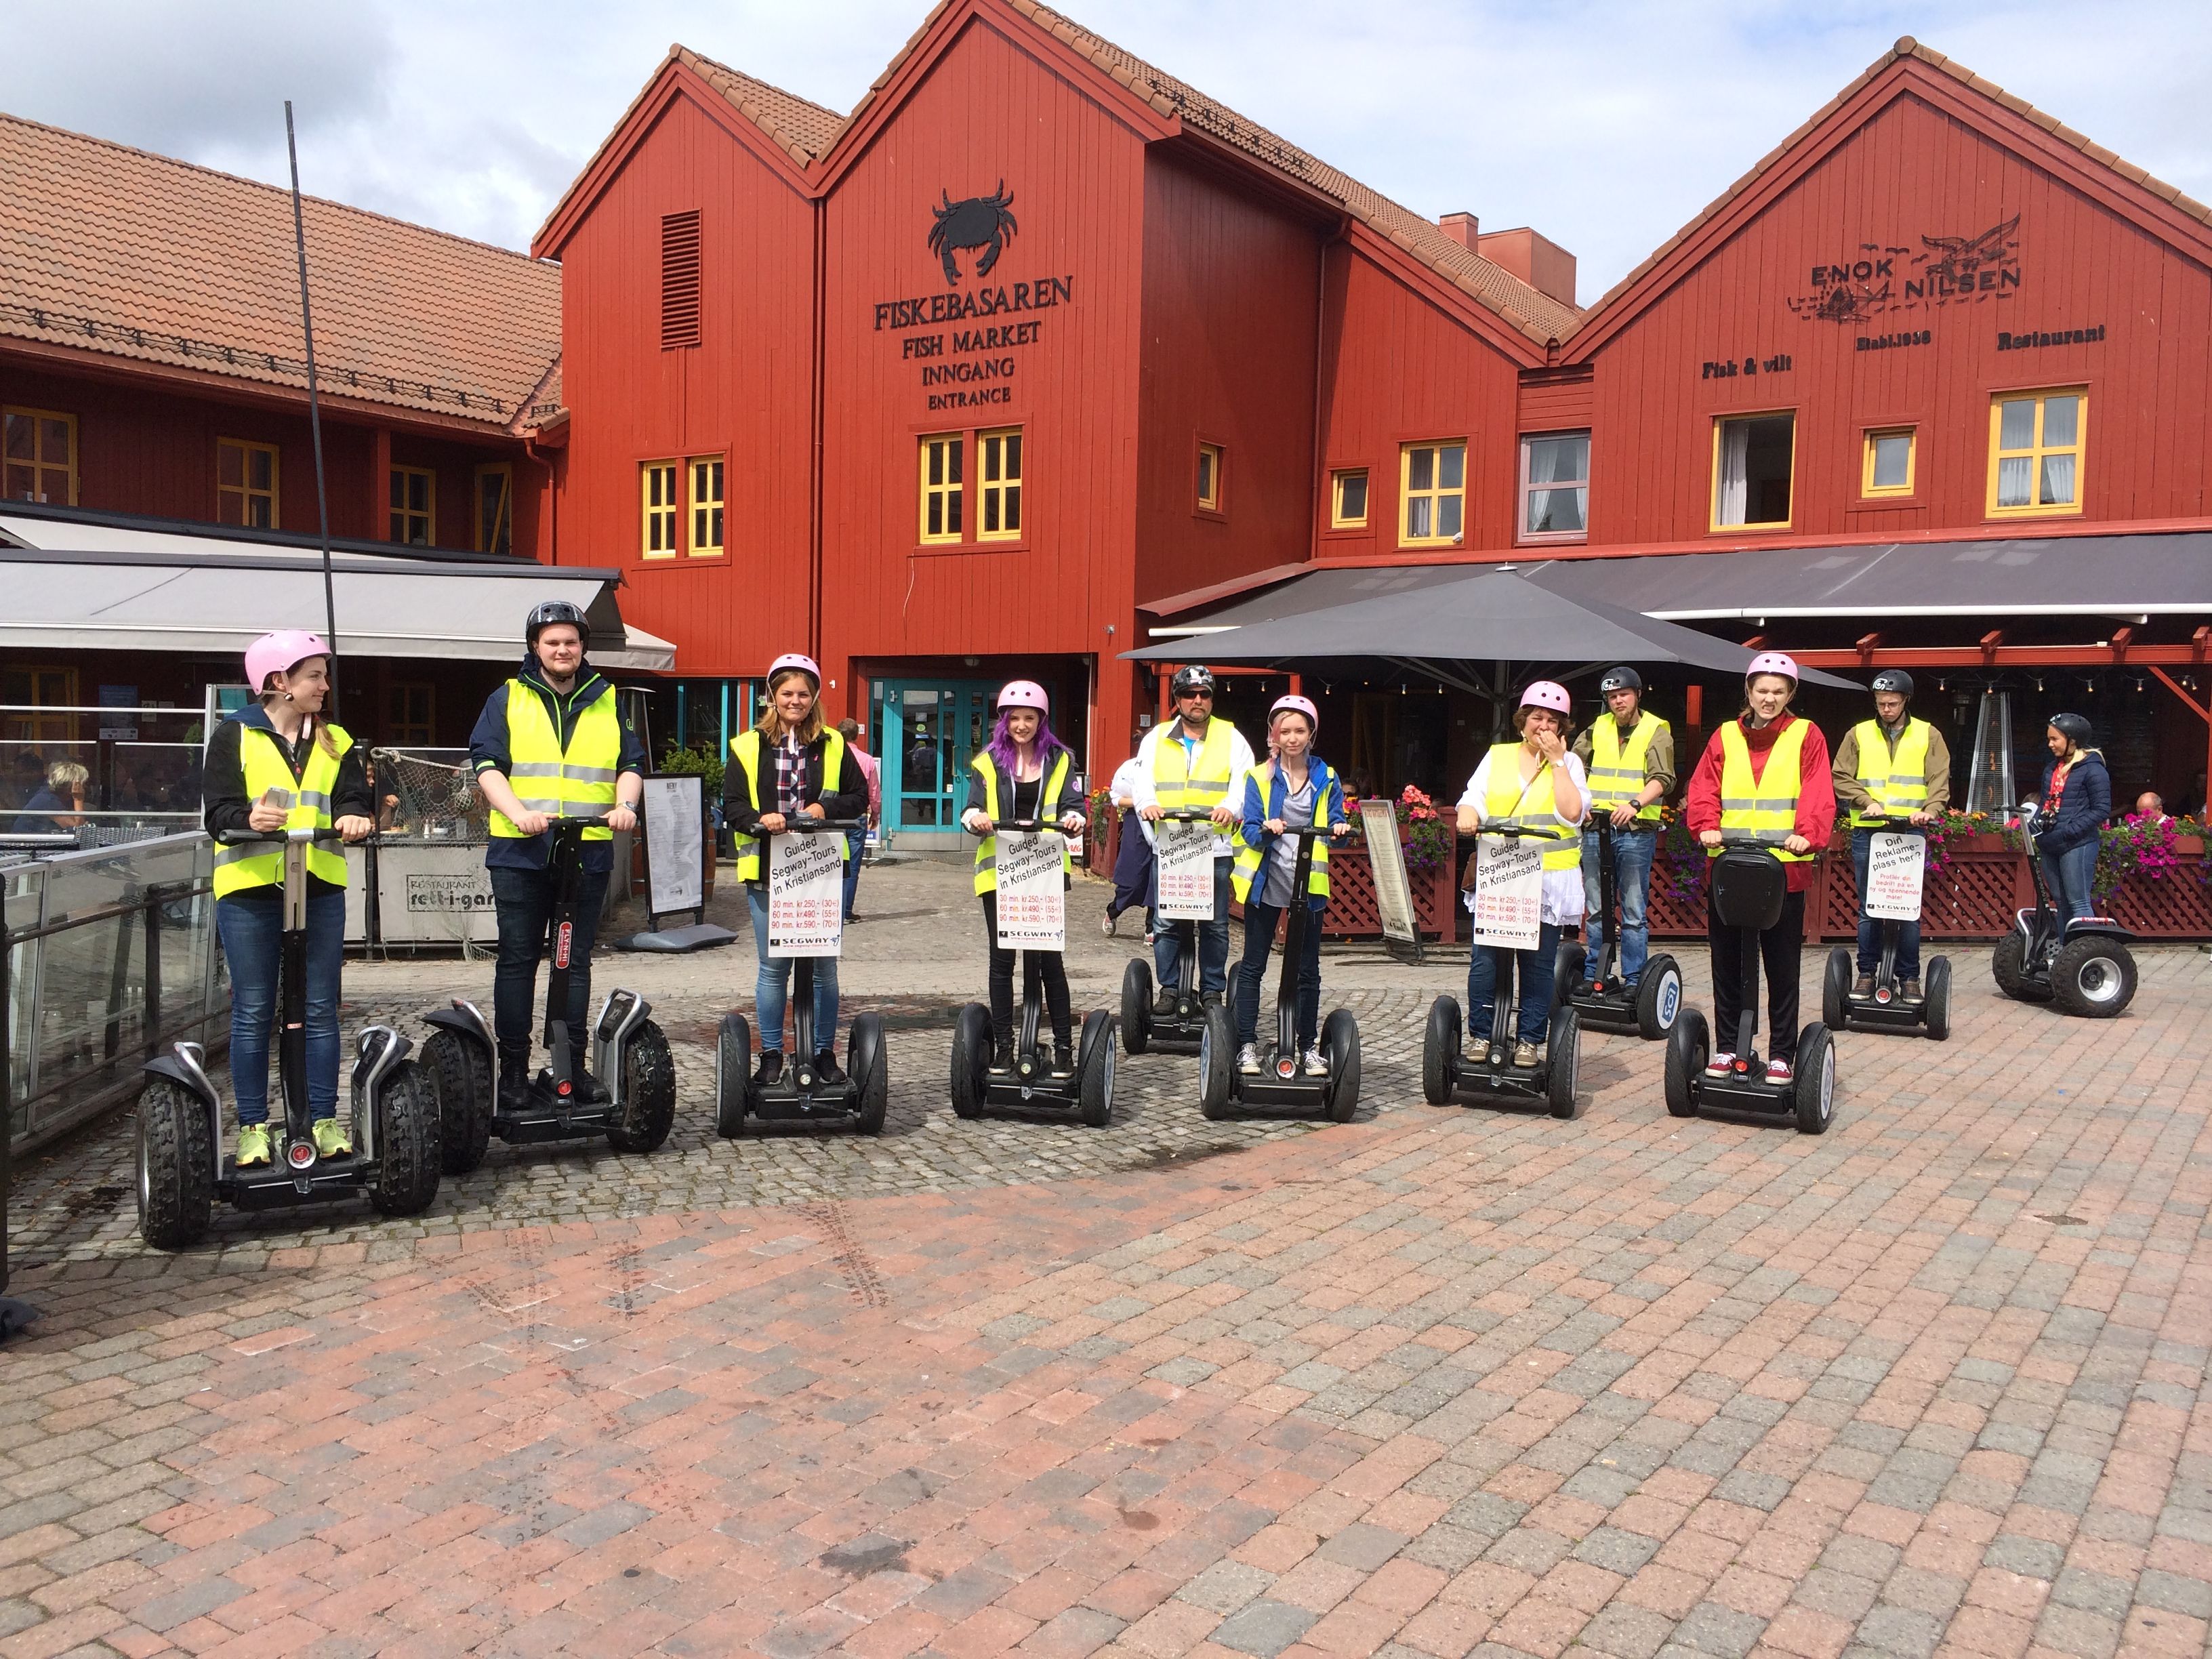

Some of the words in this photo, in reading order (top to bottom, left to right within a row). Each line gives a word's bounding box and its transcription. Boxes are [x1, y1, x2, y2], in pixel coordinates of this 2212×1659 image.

[1811, 258, 1893, 286] ENOK
[1905, 267, 2021, 300] NILSEN
[874, 275, 1073, 331] FISKEBASAREN
[902, 335, 943, 359] FISH
[952, 321, 1041, 353] MARKET
[1997, 325, 2105, 351] Restaurant
[922, 357, 1015, 386] INNGANG
[1702, 360, 1738, 379] Fisk
[1744, 358, 1757, 375] &
[1763, 354, 1791, 373] vilt
[928, 386, 1011, 410] ENTRANCE
[1009, 835, 1038, 855] Guided
[1160, 834, 1208, 858] Segway-Tours
[1169, 825, 1193, 842] Guided
[1885, 838, 1903, 847] Din
[785, 836, 817, 858] Guided
[998, 844, 1057, 875] Segway-Tours
[1162, 862, 1168, 870] in
[1170, 842, 1212, 867] Kristiansand
[1491, 840, 1519, 858] Guided
[1875, 844, 1919, 859] Reklame-
[772, 845, 836, 880] Segway-Tours
[1000, 880, 1008, 889] in
[1010, 855, 1062, 886] Kristiansand
[1479, 850, 1537, 876] Segway-Tours
[1479, 880, 1487, 889] in
[1490, 861, 1541, 886] Kristiansand
[1872, 859, 1896, 872] plass
[411, 881, 476, 890] RESTAURANT
[773, 885, 782, 895] in
[785, 857, 842, 890] Kristiansand
[1486, 928, 1528, 937] SEGWAY
[1664, 987, 1676, 1017] LOS
